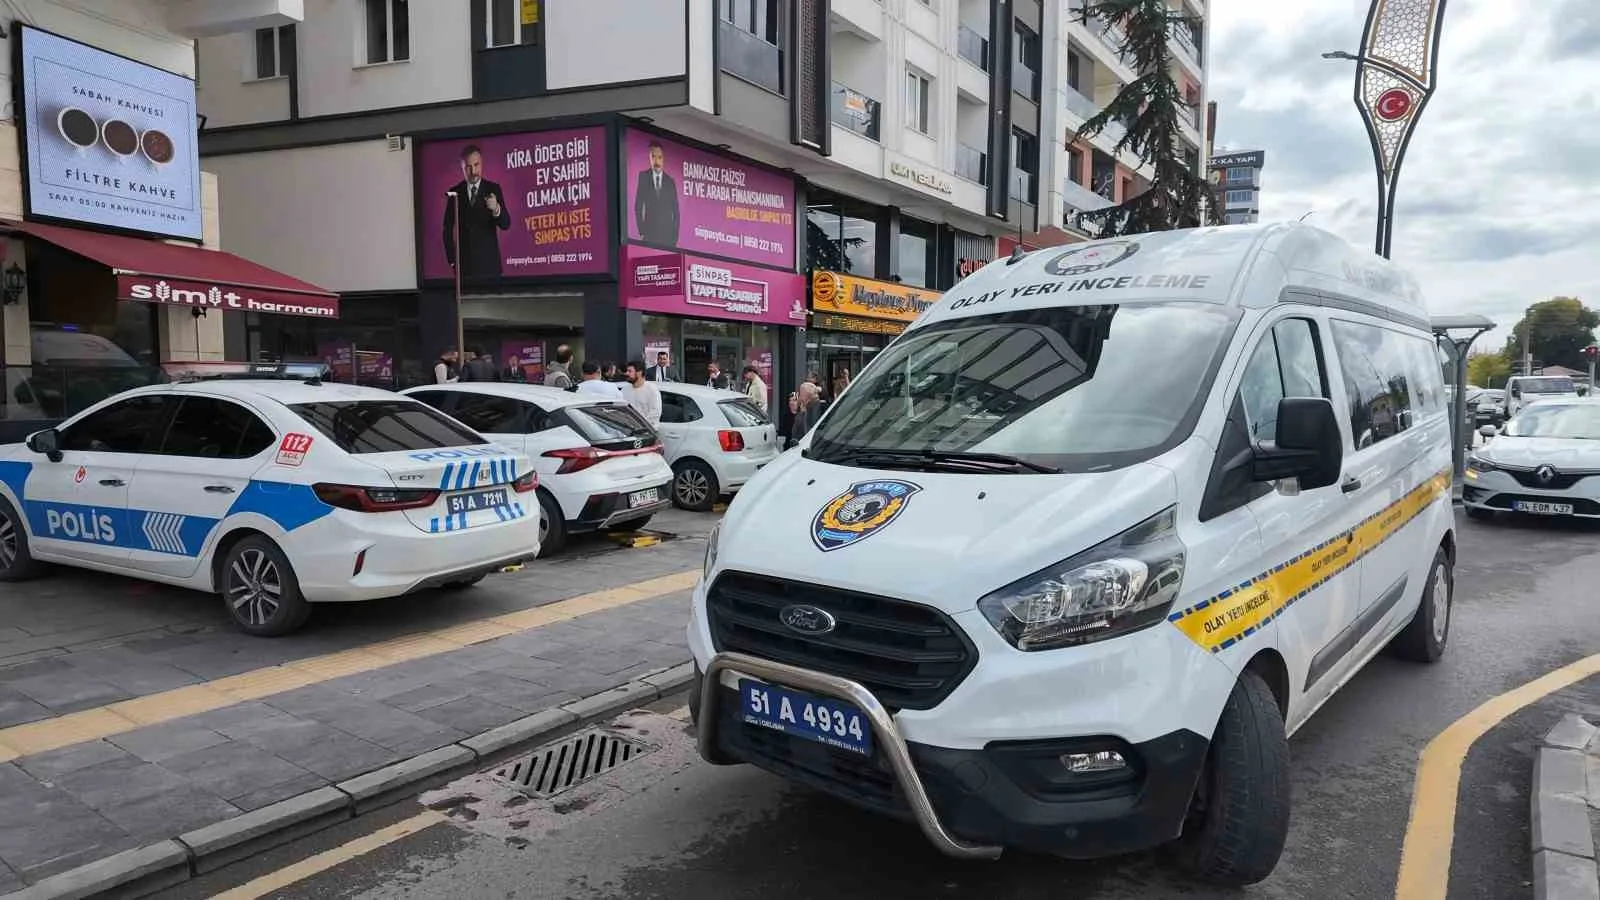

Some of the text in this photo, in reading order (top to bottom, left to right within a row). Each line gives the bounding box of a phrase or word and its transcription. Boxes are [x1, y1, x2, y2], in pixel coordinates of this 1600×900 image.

[72, 86, 111, 102] SABAH
[506, 135, 589, 169] KİRA ÖDER GİBİ
[536, 158, 590, 186] EV SAHİBİ
[683, 161, 720, 182] BANKASIZ
[65, 168, 176, 200] FİLTRE KAHVE
[527, 180, 590, 208] OLMAK İÇİN
[683, 181, 694, 195] EV
[695, 182, 705, 198] VE
[706, 184, 731, 201] ARABA
[525, 213, 558, 230] YETER
[571, 224, 591, 239] YTS
[692, 284, 716, 298] YAPI
[950, 274, 1210, 311] OLAY YERİ İNCELEME
[285, 435, 310, 451] 112
[399, 473, 424, 481] CITY
[452, 493, 503, 511] 51 A 7211
[46, 508, 116, 543] POLİS
[1204, 614, 1227, 634] OLAY
[750, 687, 770, 715] 51
[779, 696, 796, 724] A
[803, 703, 863, 741] 4934
